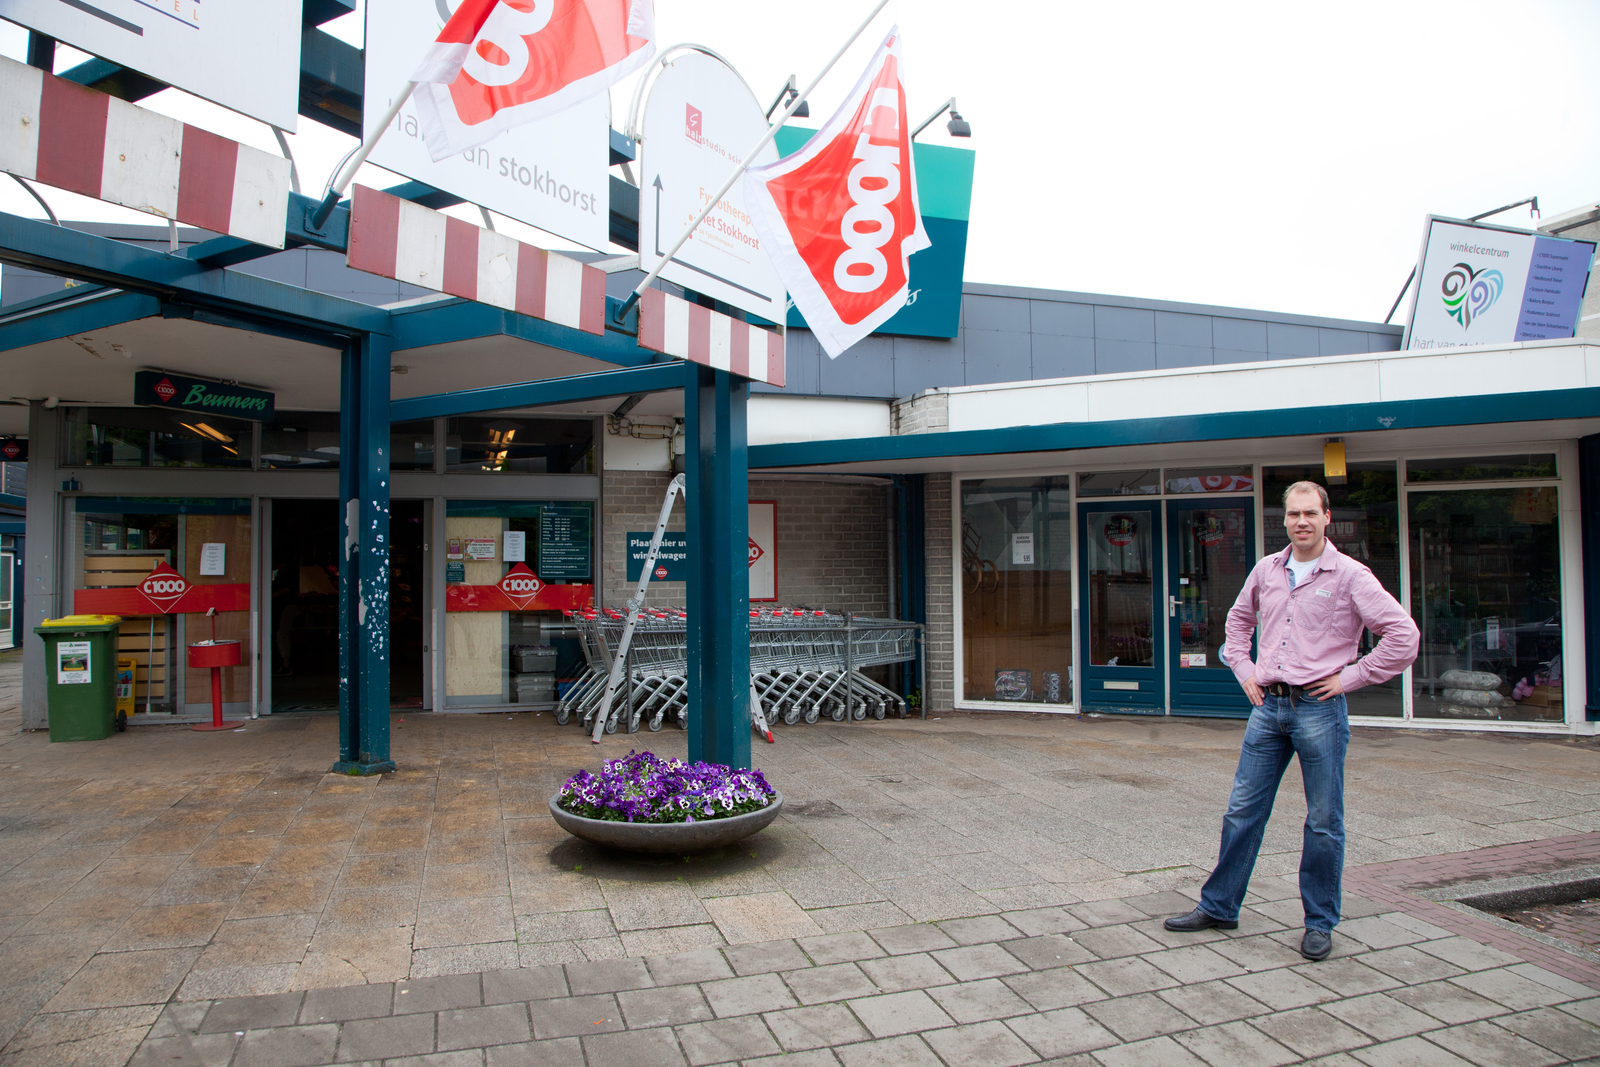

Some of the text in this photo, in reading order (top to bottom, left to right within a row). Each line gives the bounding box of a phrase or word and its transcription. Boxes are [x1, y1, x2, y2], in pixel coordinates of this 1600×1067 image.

[462, 147, 490, 170] an
[498, 156, 597, 216] stokhorst
[717, 218, 759, 250] Stokhorst
[1450, 241, 1510, 258] winkelcentrum
[1413, 336, 1435, 349] hart
[158, 384, 268, 410] C1000 Beumers
[1326, 522, 1354, 535] DVD
[144, 580, 186, 594] C1000
[502, 579, 540, 592] C1000
